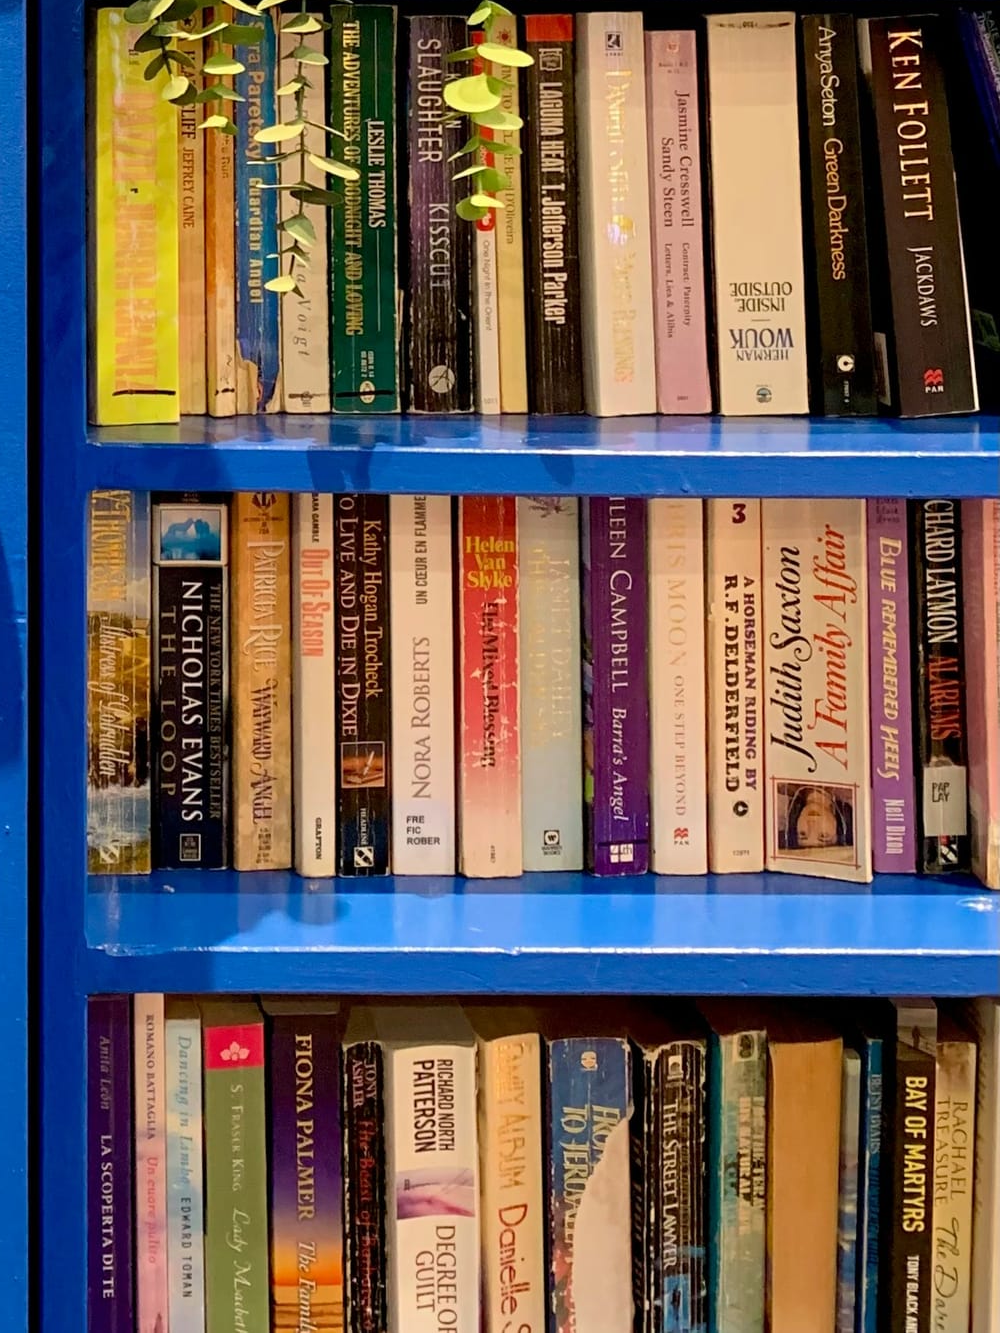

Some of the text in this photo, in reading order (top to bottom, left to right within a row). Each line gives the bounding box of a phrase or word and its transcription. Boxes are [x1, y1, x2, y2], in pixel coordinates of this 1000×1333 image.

[417, 37, 443, 163] SLAUGHTER
[367, 120, 386, 229] LESLIE THOMAS
[660, 136, 677, 227] Sandy Steen
[674, 89, 695, 227] Jasmine Cresswell
[887, 28, 938, 327] KEN FOLLETT JACKDAWS
[428, 202, 450, 289] KISSCUT
[505, 193, 517, 245] D'Oliveira
[729, 280, 794, 297] OUTSIDE
[729, 327, 795, 349] WOUK
[735, 348, 790, 361] HERMAN
[924, 385, 944, 394] PAN
[464, 535, 515, 554] Helen
[732, 502, 747, 524] 3
[302, 548, 330, 657] OUT OF SEASON
[466, 569, 513, 589] Slyke
[474, 553, 506, 570] Van
[243, 539, 286, 673] PATRICIA RICE
[358, 519, 384, 698] Kathy Hogan Trocheck
[807, 523, 858, 771] A Family Affair
[160, 605, 177, 796] THE LOOP
[181, 580, 204, 822] NICHOLAS EVANS
[209, 583, 222, 819] THE NEW YORK TIMES BESTSELLER
[743, 575, 758, 790] A HORSEMAN RIDING BY
[769, 545, 818, 774] Judith Saxton
[250, 677, 279, 761] WAYWARD
[411, 635, 432, 799] NORA ROBERTS
[250, 762, 279, 825] ANGEL
[406, 815, 425, 824] FRE
[931, 782, 950, 792] PAP
[931, 793, 950, 803] LAY
[315, 817, 323, 861] GRAFTON
[406, 825, 421, 835] FIC
[406, 836, 440, 846] ROBER
[352, 1058, 365, 1108] ASPLER
[363, 1057, 378, 1099] TONY
[412, 1059, 438, 1154] PATTERSON
[436, 1058, 455, 1152] RICHARD NORTH
[560, 1105, 588, 1134] TO
[662, 1101, 680, 1268] THE STREET LAWYER
[950, 1100, 969, 1200] RACHAEL
[902, 1075, 928, 1316] BAY OF MARTYRS TONY BLACK
[415, 1250, 436, 1313] GUILT
